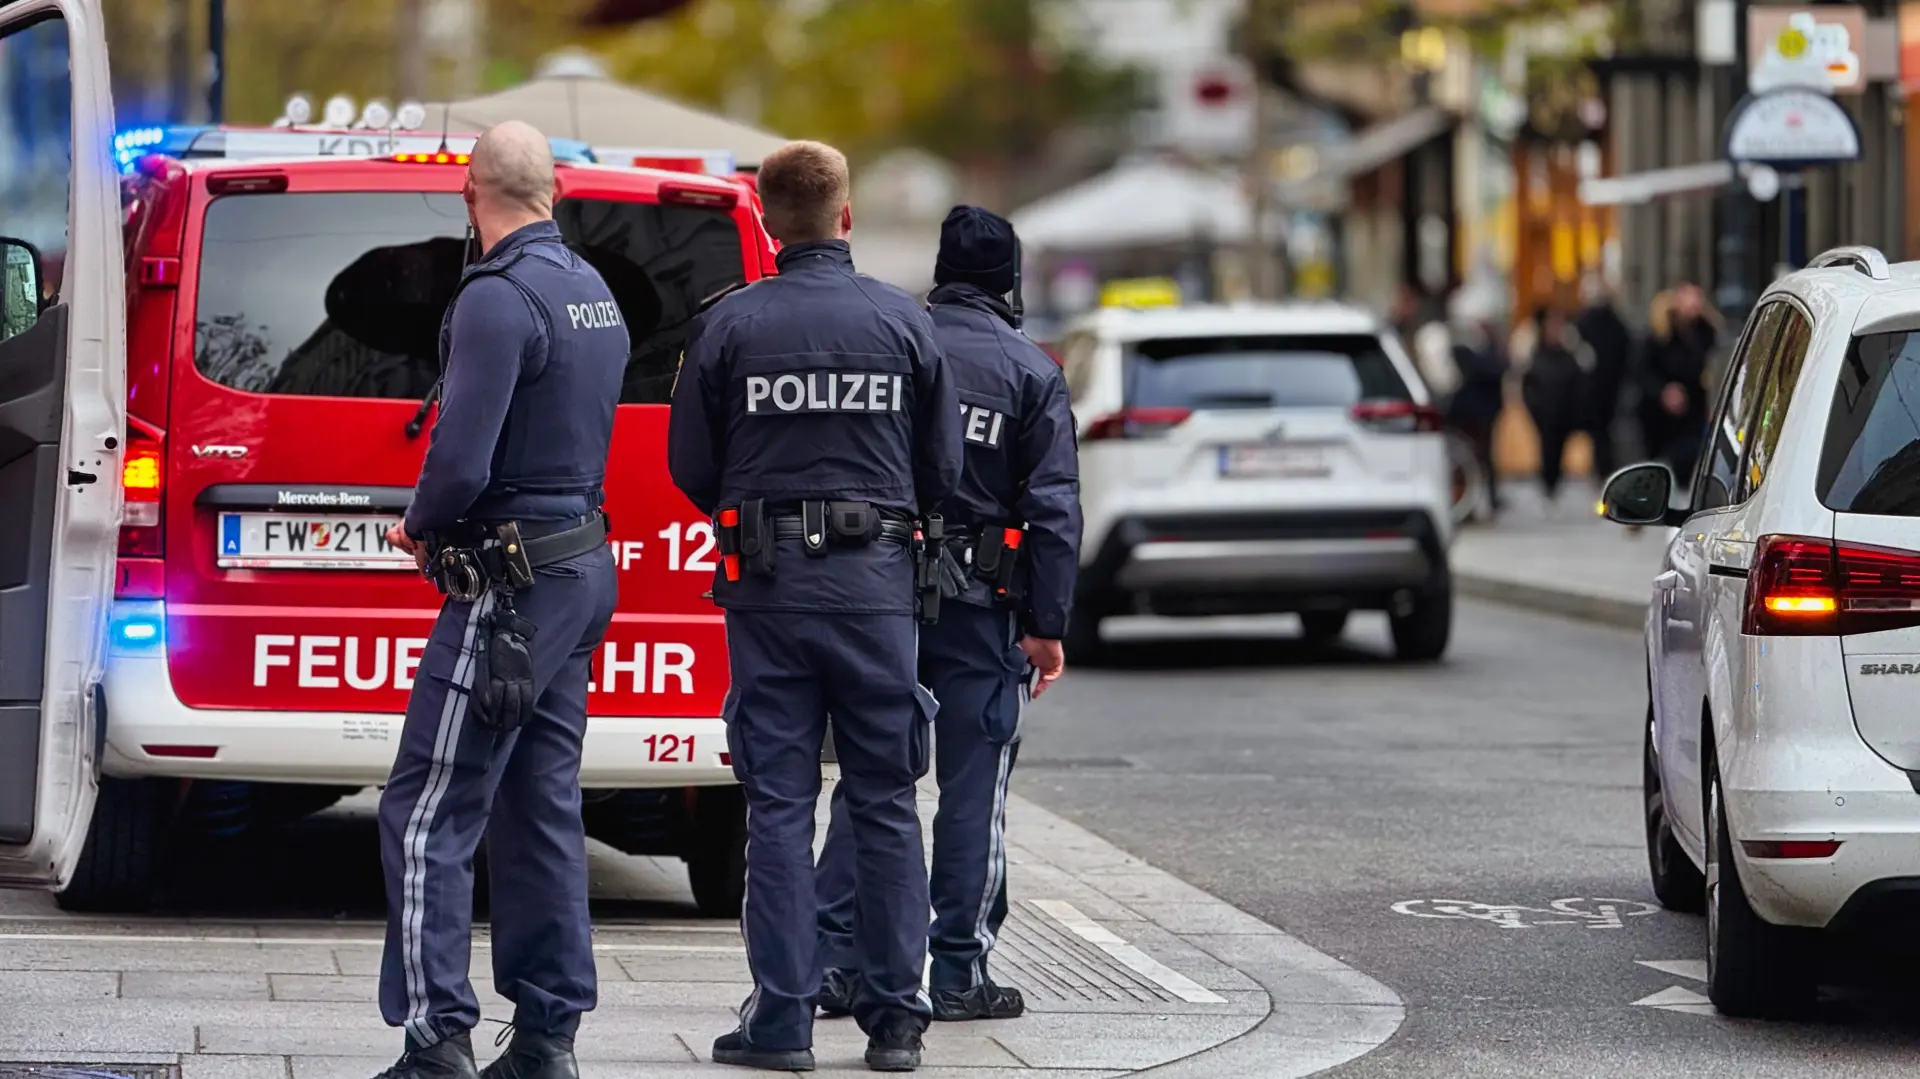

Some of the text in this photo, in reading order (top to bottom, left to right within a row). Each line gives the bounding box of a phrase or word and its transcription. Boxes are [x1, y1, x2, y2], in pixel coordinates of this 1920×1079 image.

[566, 300, 621, 330] POLIZEI
[747, 373, 902, 412] POLIZEI
[960, 403, 1003, 445] EI
[192, 444, 248, 458] VITO
[278, 490, 371, 506] Mercedes-Benz
[228, 540, 237, 550] A
[265, 521, 308, 552] FW
[253, 634, 696, 694] FEUEHR
[643, 734, 695, 762] 121
